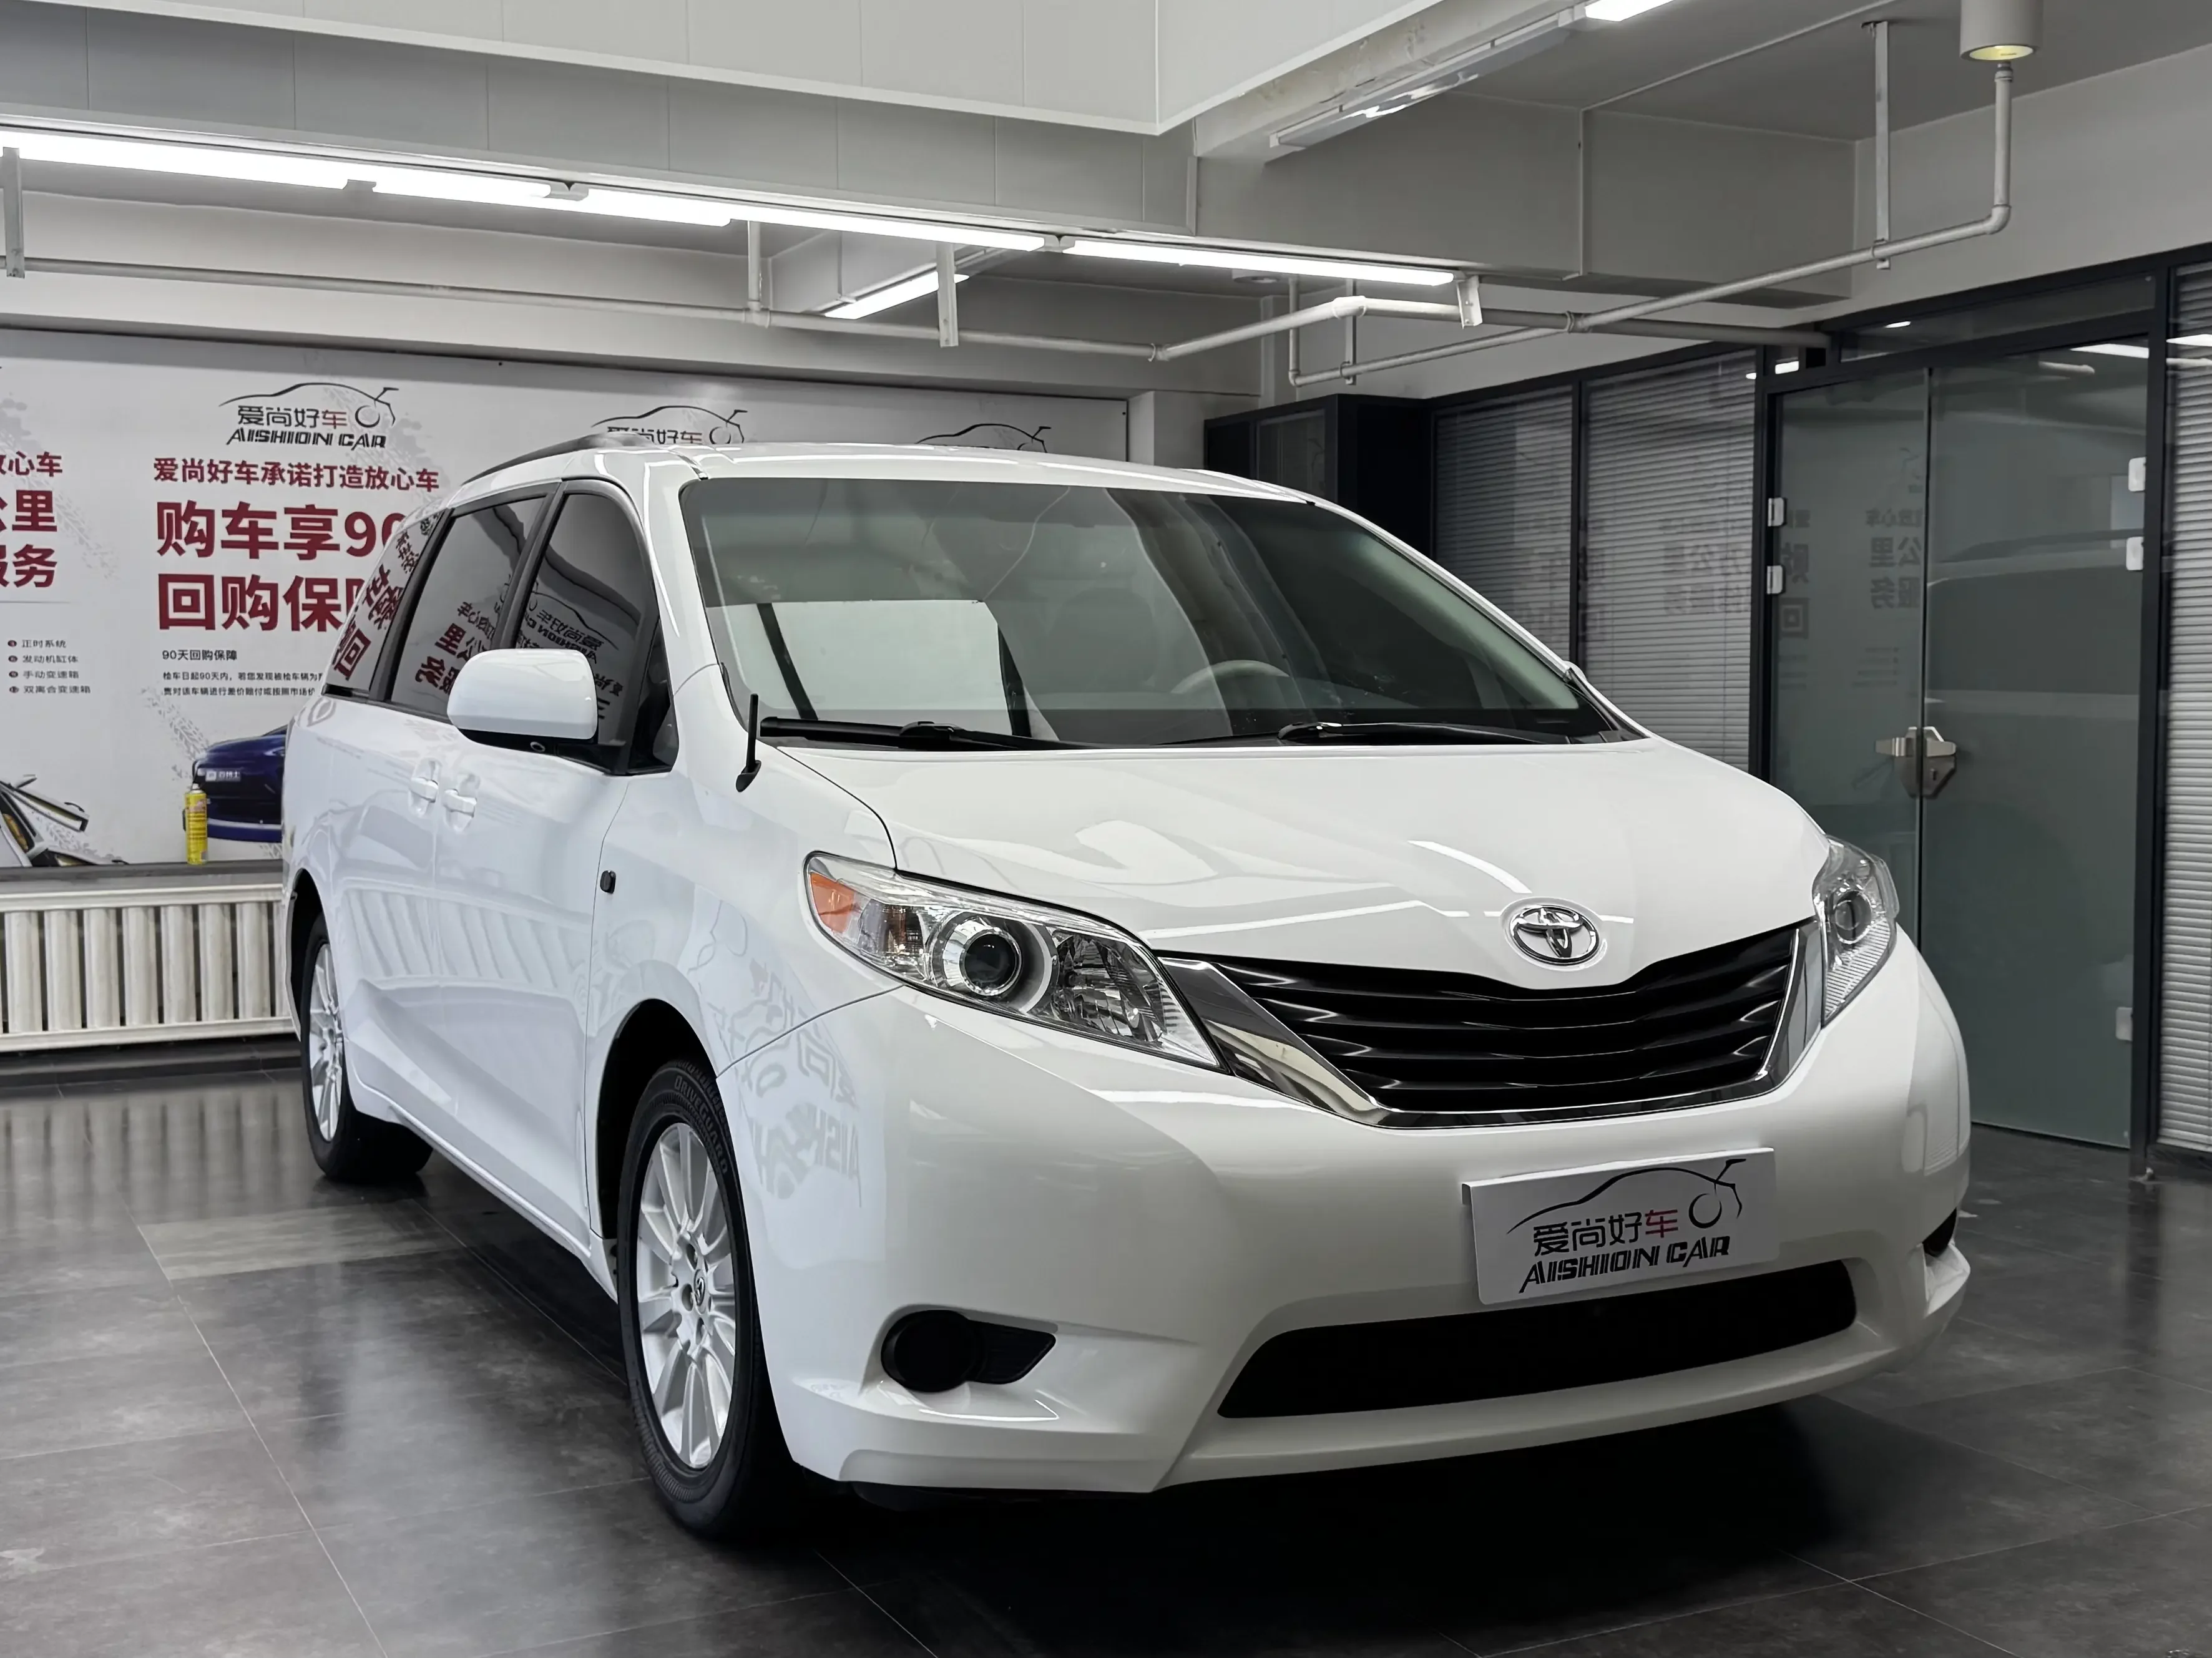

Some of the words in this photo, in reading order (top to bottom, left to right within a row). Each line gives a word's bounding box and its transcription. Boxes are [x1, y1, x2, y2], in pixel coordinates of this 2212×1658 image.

[238, 404, 348, 429] 爱尚好车
[227, 428, 333, 446] AISHION
[338, 432, 386, 450] CAR
[0, 451, 62, 477] 心车
[154, 457, 439, 493] 爱尚好车承诺打造放心车
[0, 490, 57, 532] 里
[0, 544, 57, 588] 务
[21, 640, 67, 648] 正时系统
[162, 650, 237, 661] 90天回购保障
[22, 655, 78, 664] 发动机缸体
[23, 671, 79, 679] 手动变速箱
[24, 685, 91, 694] 双离合变速箱
[1532, 1209, 1679, 1257] 爱尚好车
[1519, 1246, 1660, 1294] AISHION
[1666, 1235, 1731, 1268] CAR
